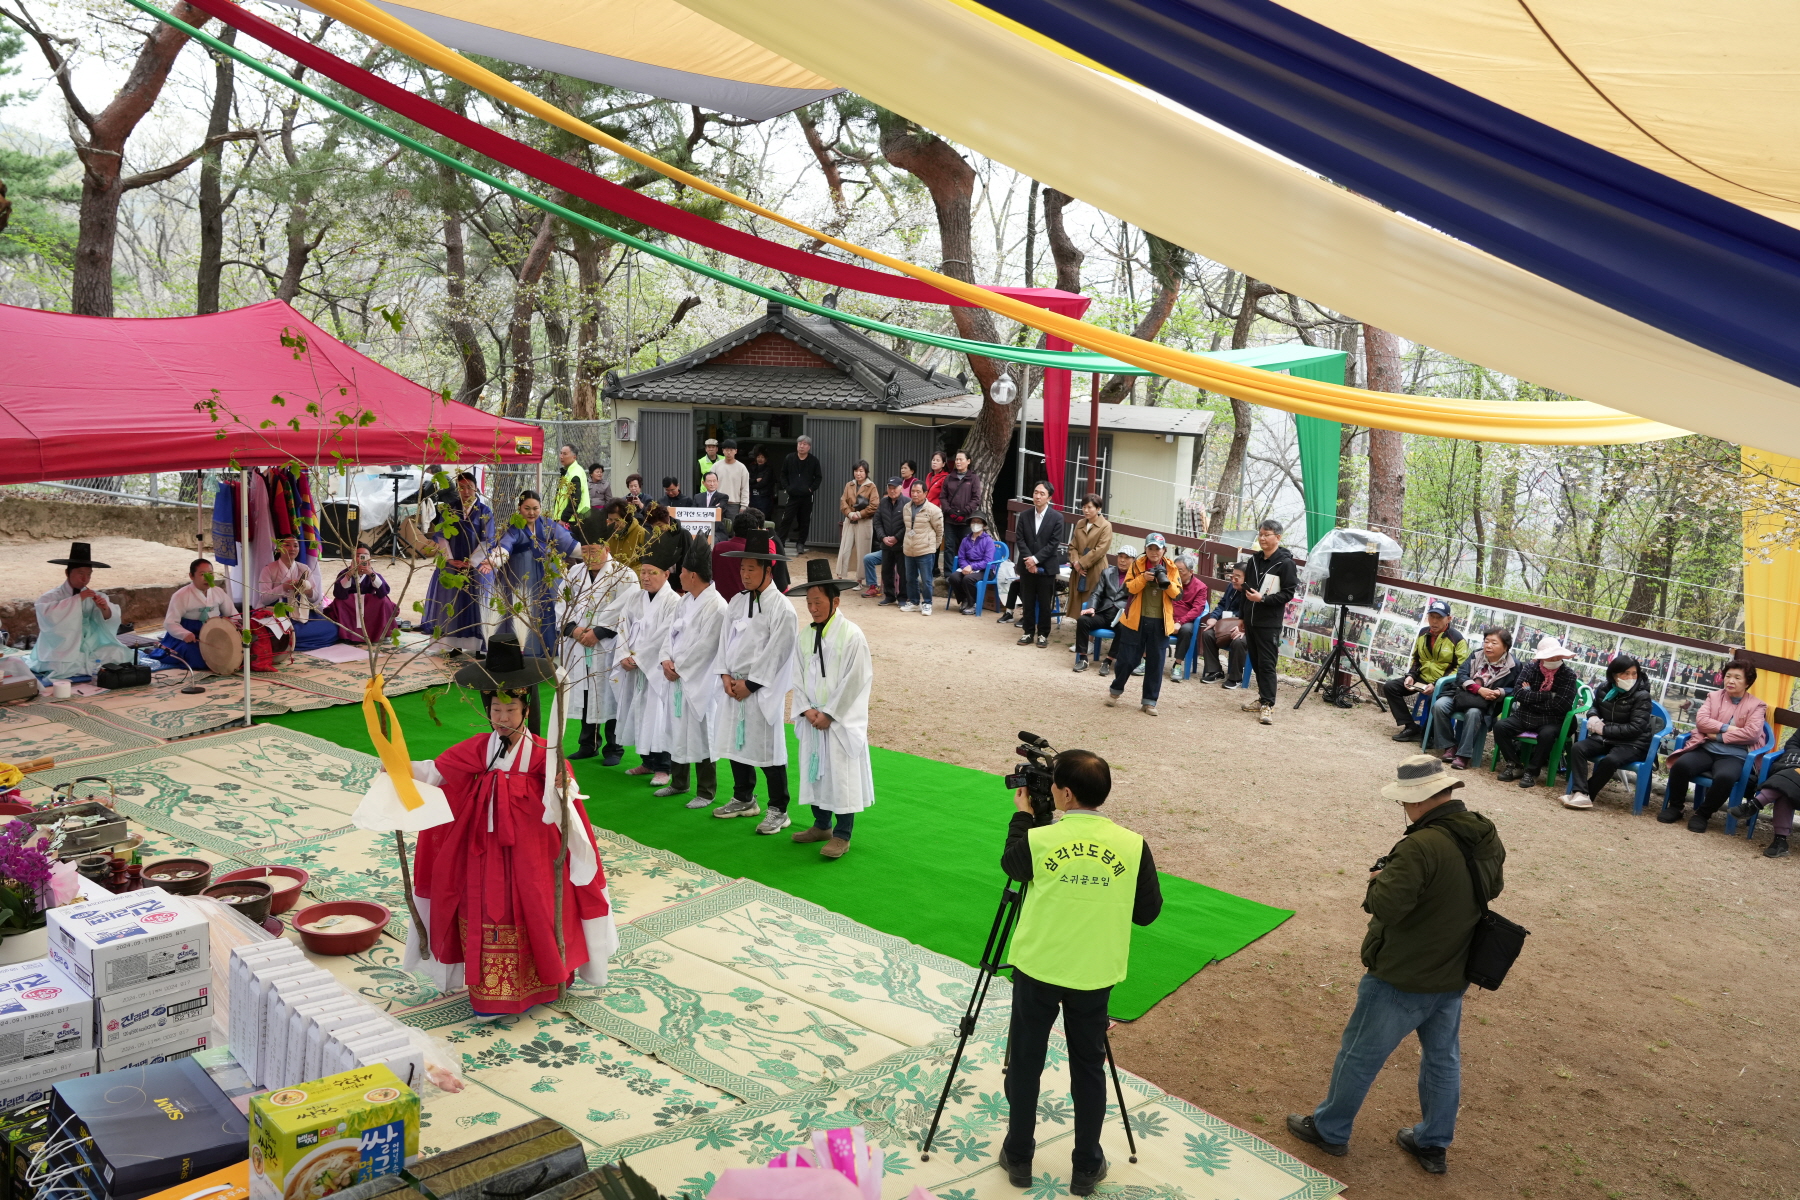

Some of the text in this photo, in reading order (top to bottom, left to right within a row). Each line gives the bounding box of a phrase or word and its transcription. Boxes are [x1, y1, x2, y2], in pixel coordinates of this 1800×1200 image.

[1044, 843, 1127, 877] 삼각산도당제
[1059, 874, 1110, 887] 소귀골모임
[85, 899, 165, 926] 진라면
[153, 1097, 184, 1121] SPAM
[297, 1133, 318, 1145] 백제
[357, 1125, 398, 1176] 쌀국
[181, 1158, 190, 1179] SPAM
